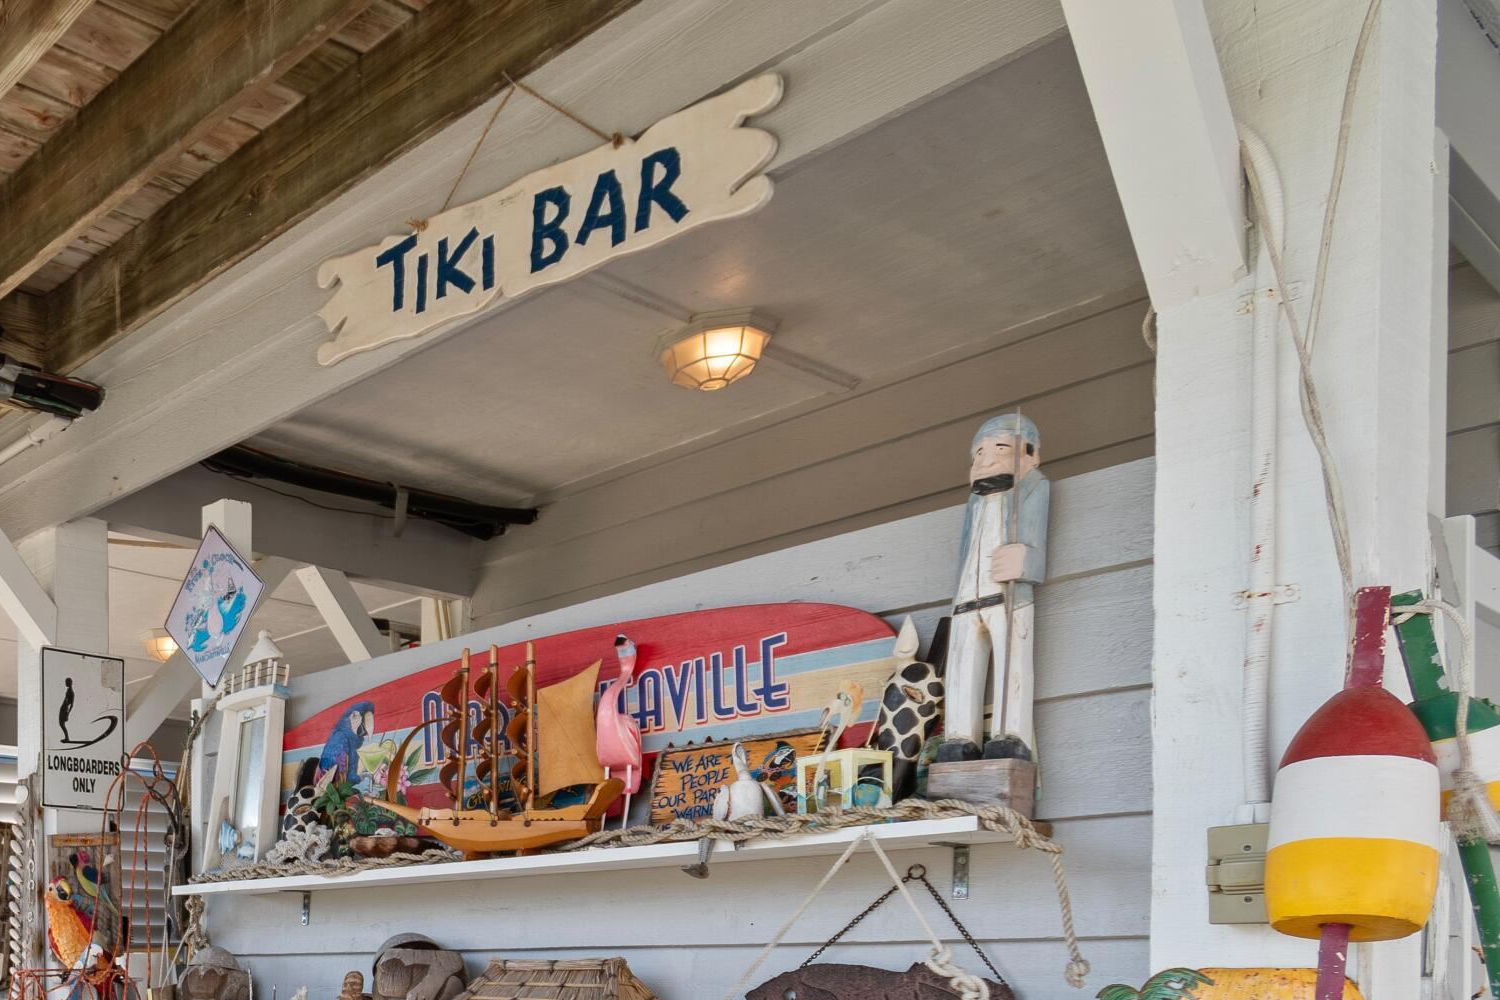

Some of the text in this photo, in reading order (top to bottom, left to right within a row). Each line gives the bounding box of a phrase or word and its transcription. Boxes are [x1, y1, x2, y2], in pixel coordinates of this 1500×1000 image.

[376, 146, 691, 314] TIKI BAR
[47, 755, 120, 776] LONGBOARDERS
[672, 756, 693, 774] WE
[695, 754, 722, 772] ARE
[72, 777, 96, 793] ONLY
[680, 767, 730, 791] PEOPLE
[658, 792, 687, 809] OUR
